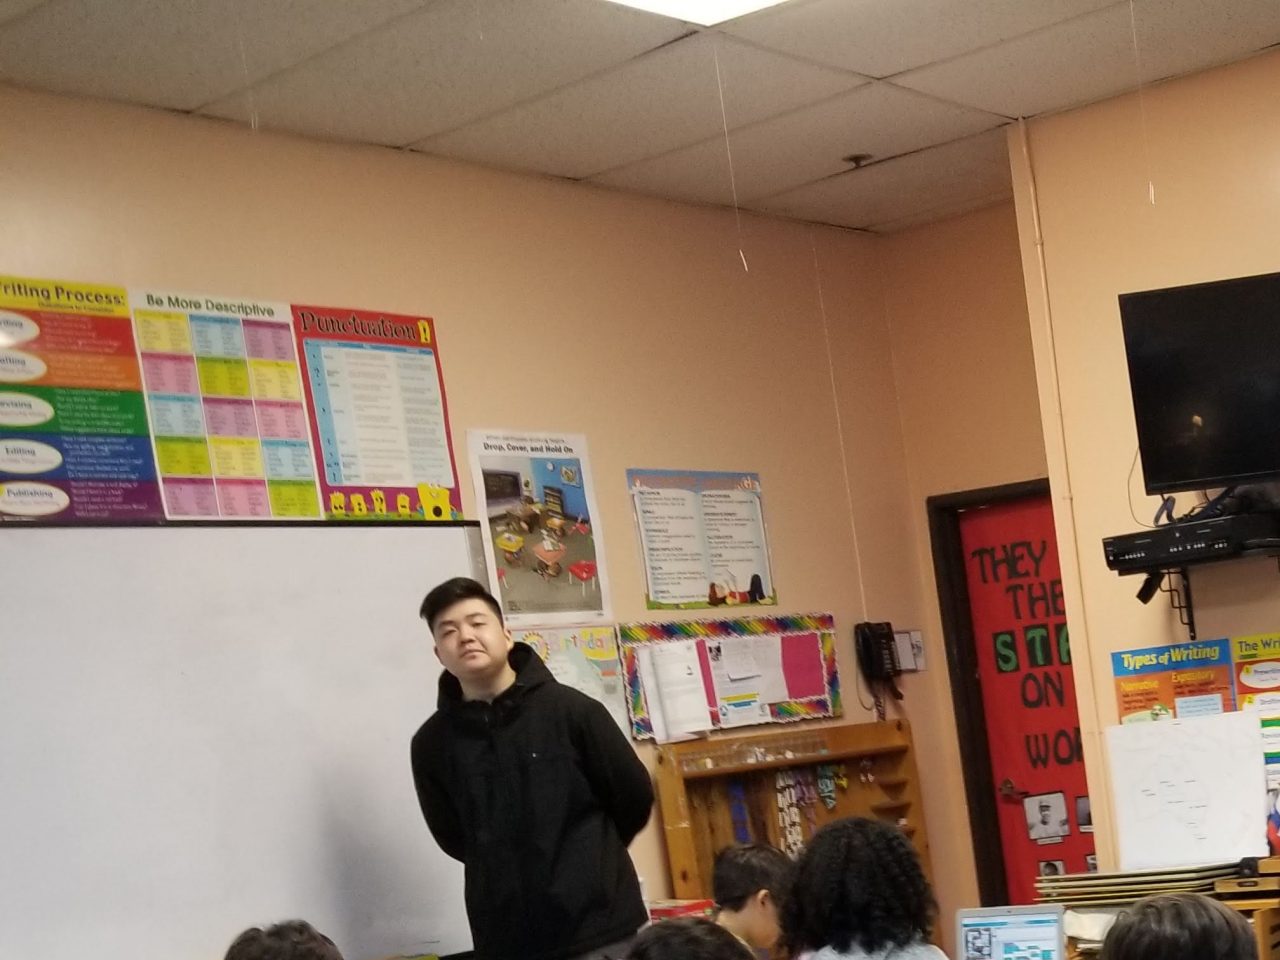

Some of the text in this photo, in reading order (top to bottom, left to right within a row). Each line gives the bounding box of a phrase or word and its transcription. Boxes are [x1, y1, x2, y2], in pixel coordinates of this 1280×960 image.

[0, 281, 125, 306] riting Process:
[146, 294, 275, 317] Be More Descriptive
[545, 445, 562, 453] Hold
[972, 541, 1047, 583] THEY
[1121, 645, 1219, 670] Types of Writing
[1238, 640, 1258, 652] The
[1021, 672, 1064, 708] ON
